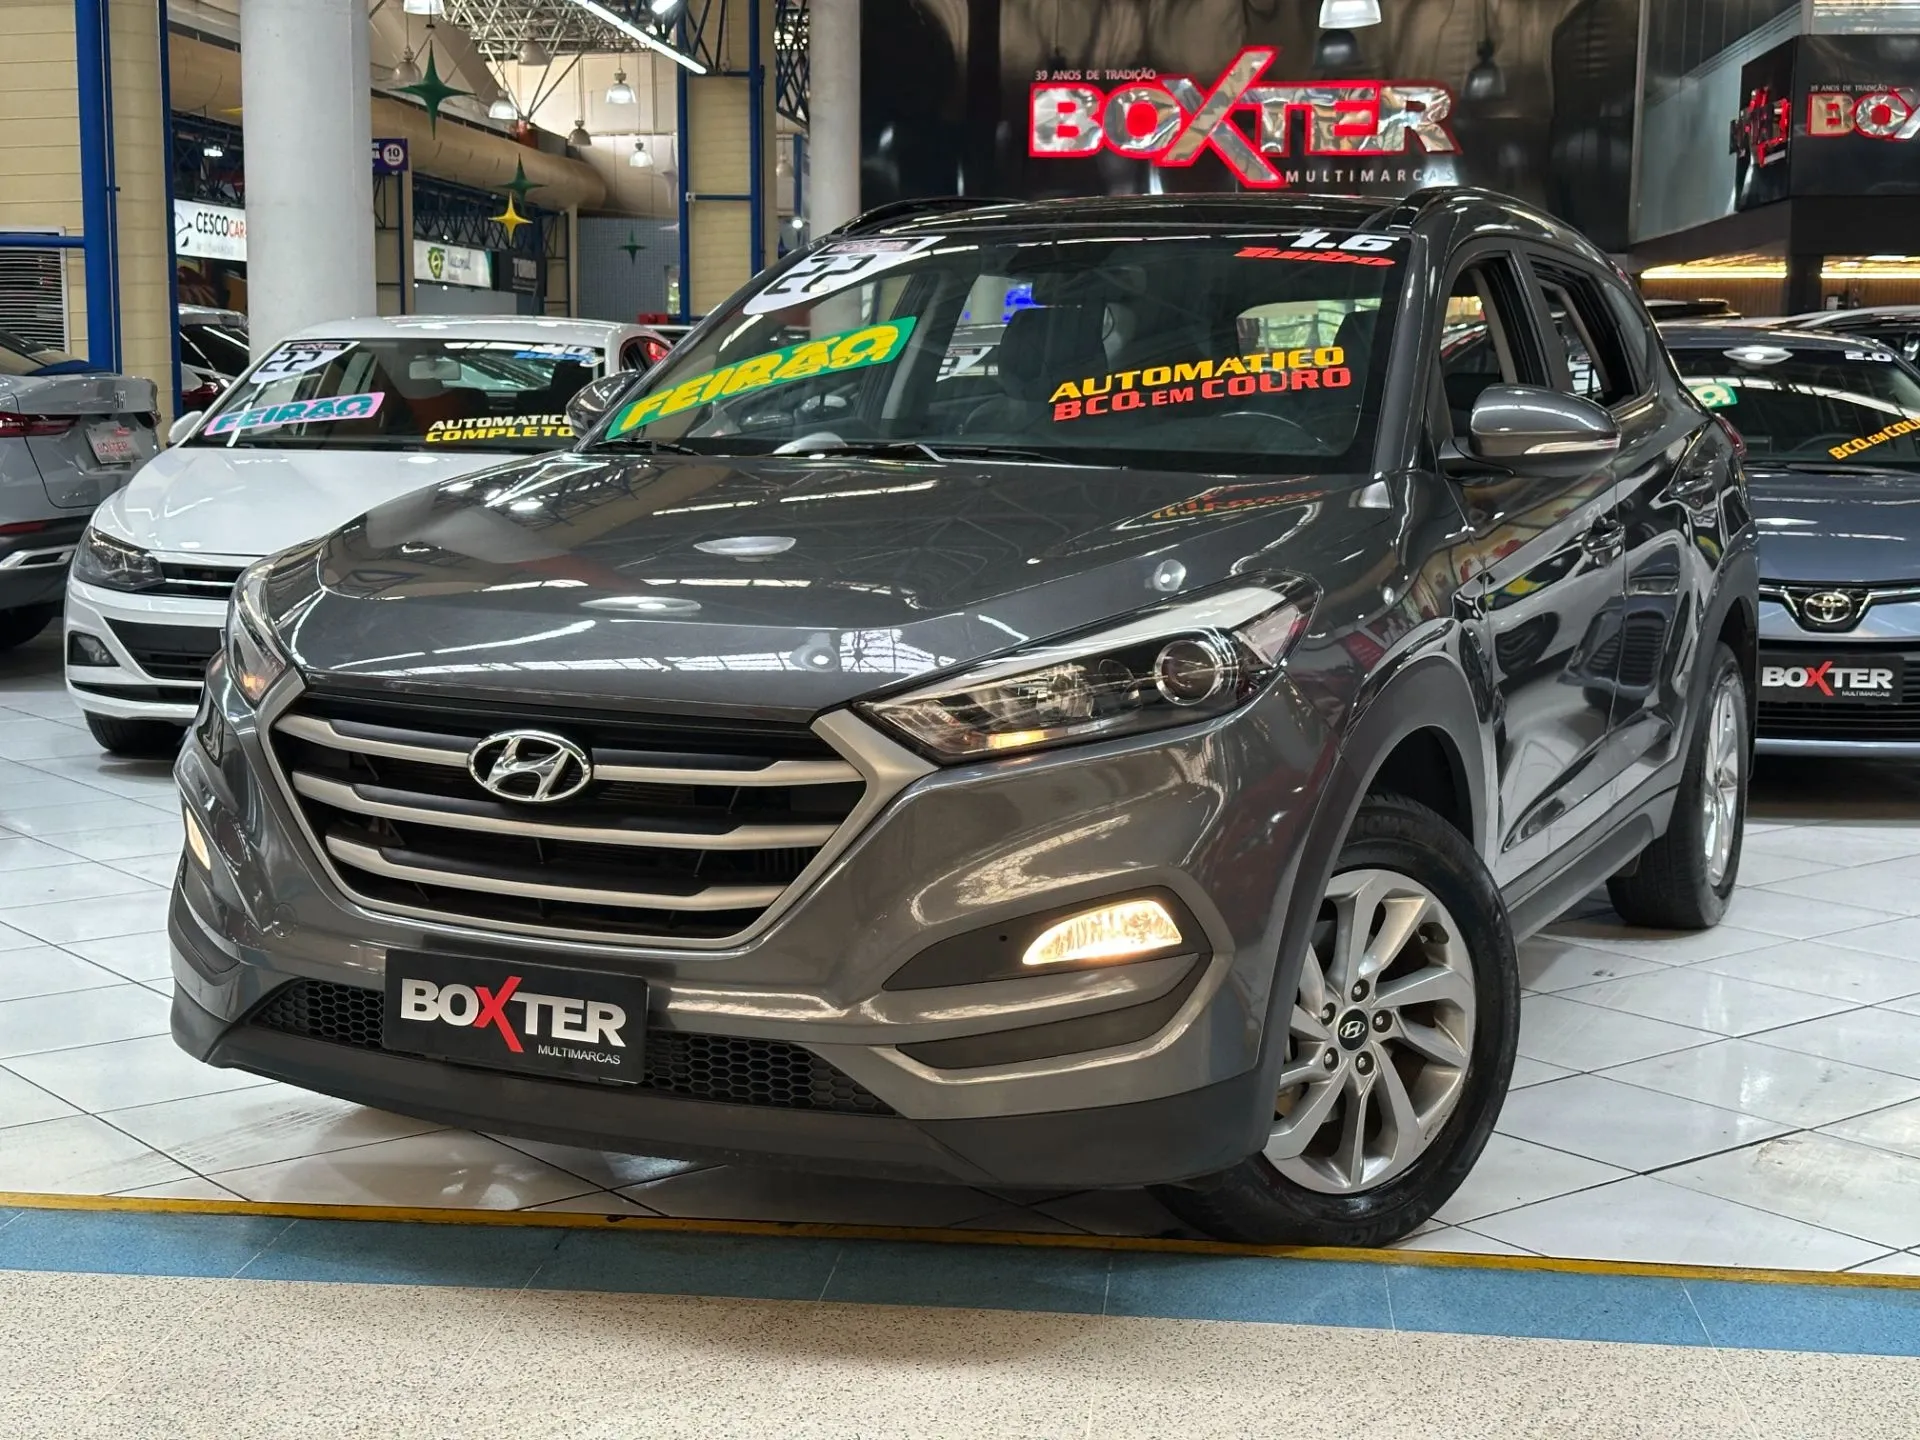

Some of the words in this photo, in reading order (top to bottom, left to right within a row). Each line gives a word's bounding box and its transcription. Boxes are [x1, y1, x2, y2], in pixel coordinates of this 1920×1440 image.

[1035, 69, 1048, 81] 39
[1052, 70, 1081, 80] ANOS
[1086, 70, 1099, 80] DE
[1105, 67, 1156, 82] TRADIÇÃO
[1029, 45, 1461, 188] BOXTER
[386, 147, 400, 158] 10
[1285, 169, 1455, 183] MULTIMARCAS
[1290, 229, 1400, 251] 1.6
[1233, 247, 1395, 267] Turbo
[259, 351, 322, 373] 22
[1844, 350, 1892, 363] 2.0
[620, 325, 899, 431] FEIRÃO
[1152, 387, 1194, 407] EM
[1201, 367, 1351, 399] COURO
[212, 395, 374, 432] FEIRÃO
[425, 426, 576, 443] COMPLETO
[1867, 432, 1890, 445] EM
[1761, 660, 1894, 696] BOXTER
[400, 976, 627, 1053] BOXTER
[537, 1044, 621, 1065] MULTIMARCAS
